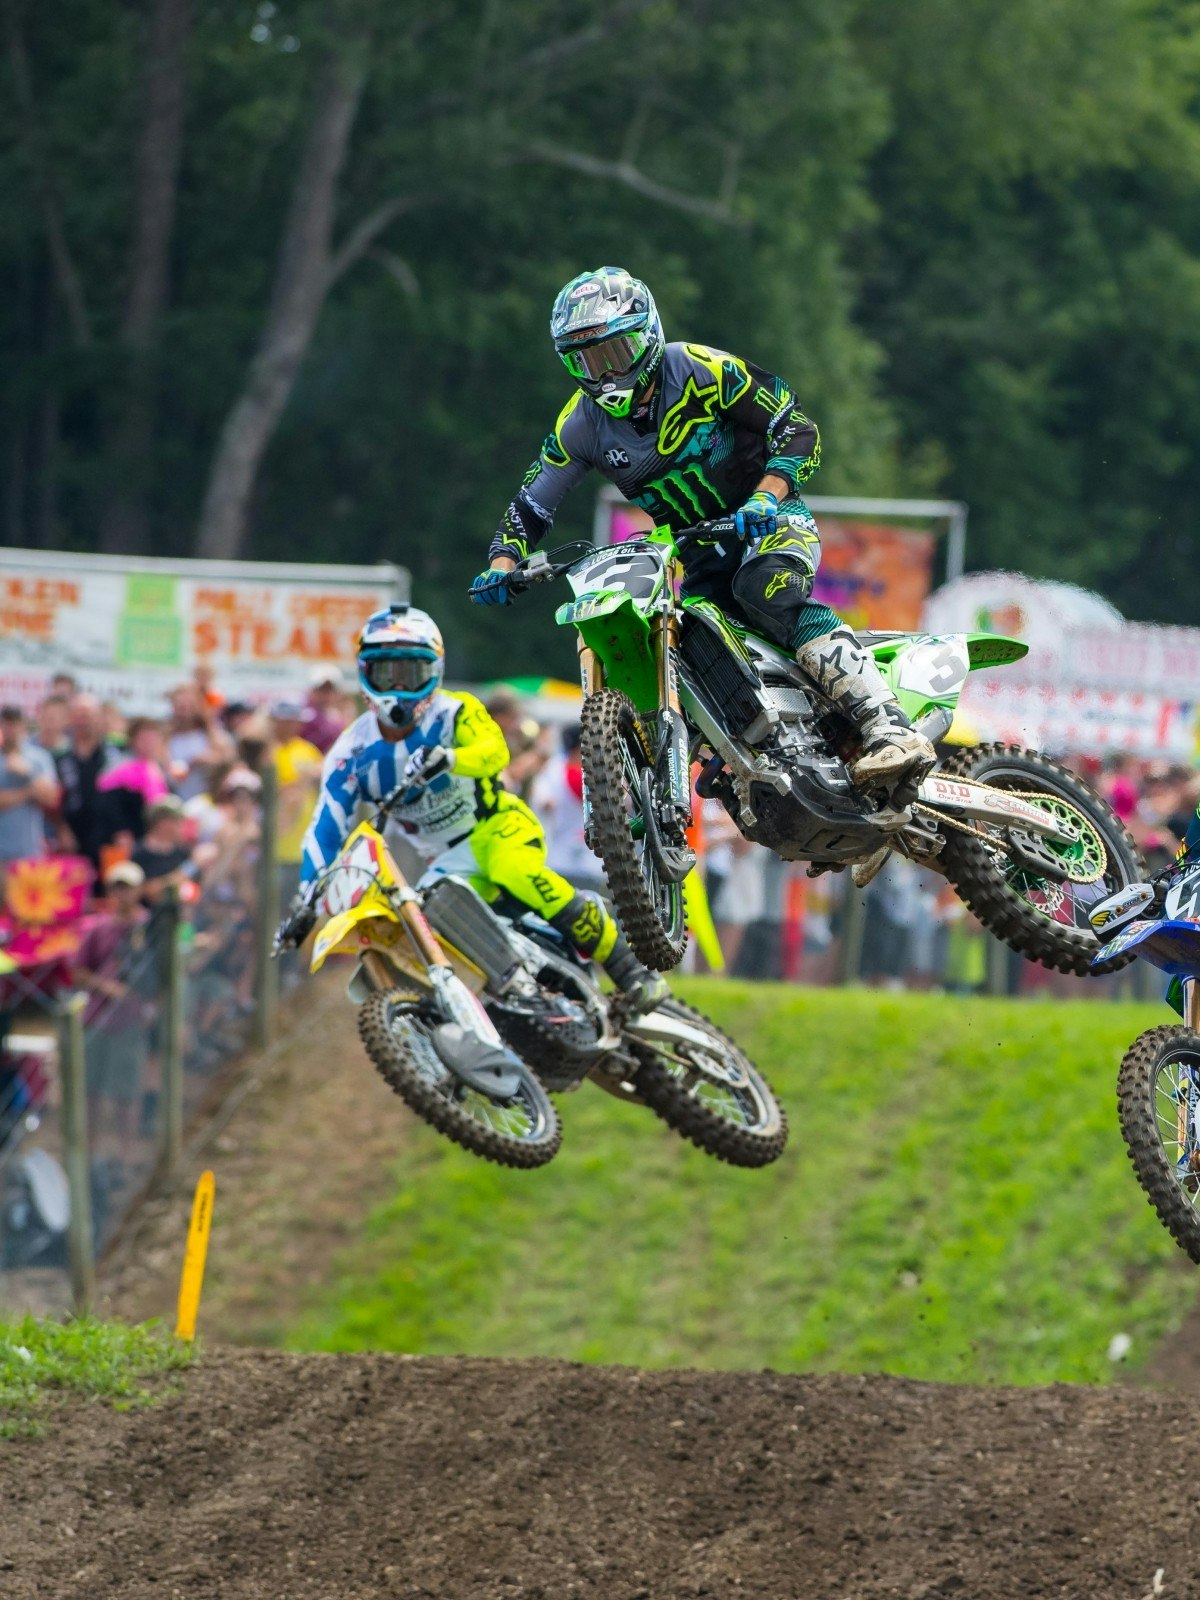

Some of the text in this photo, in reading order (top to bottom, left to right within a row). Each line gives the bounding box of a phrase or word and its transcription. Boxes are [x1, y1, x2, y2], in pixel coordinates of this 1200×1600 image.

[574, 284, 596, 296] BELL
[711, 523, 735, 532] ARC
[590, 546, 637, 567] LUCAS OIL
[584, 554, 657, 599] 3
[928, 645, 968, 694] 3
[680, 737, 691, 800] DUNLOP
[934, 781, 971, 798] DID
